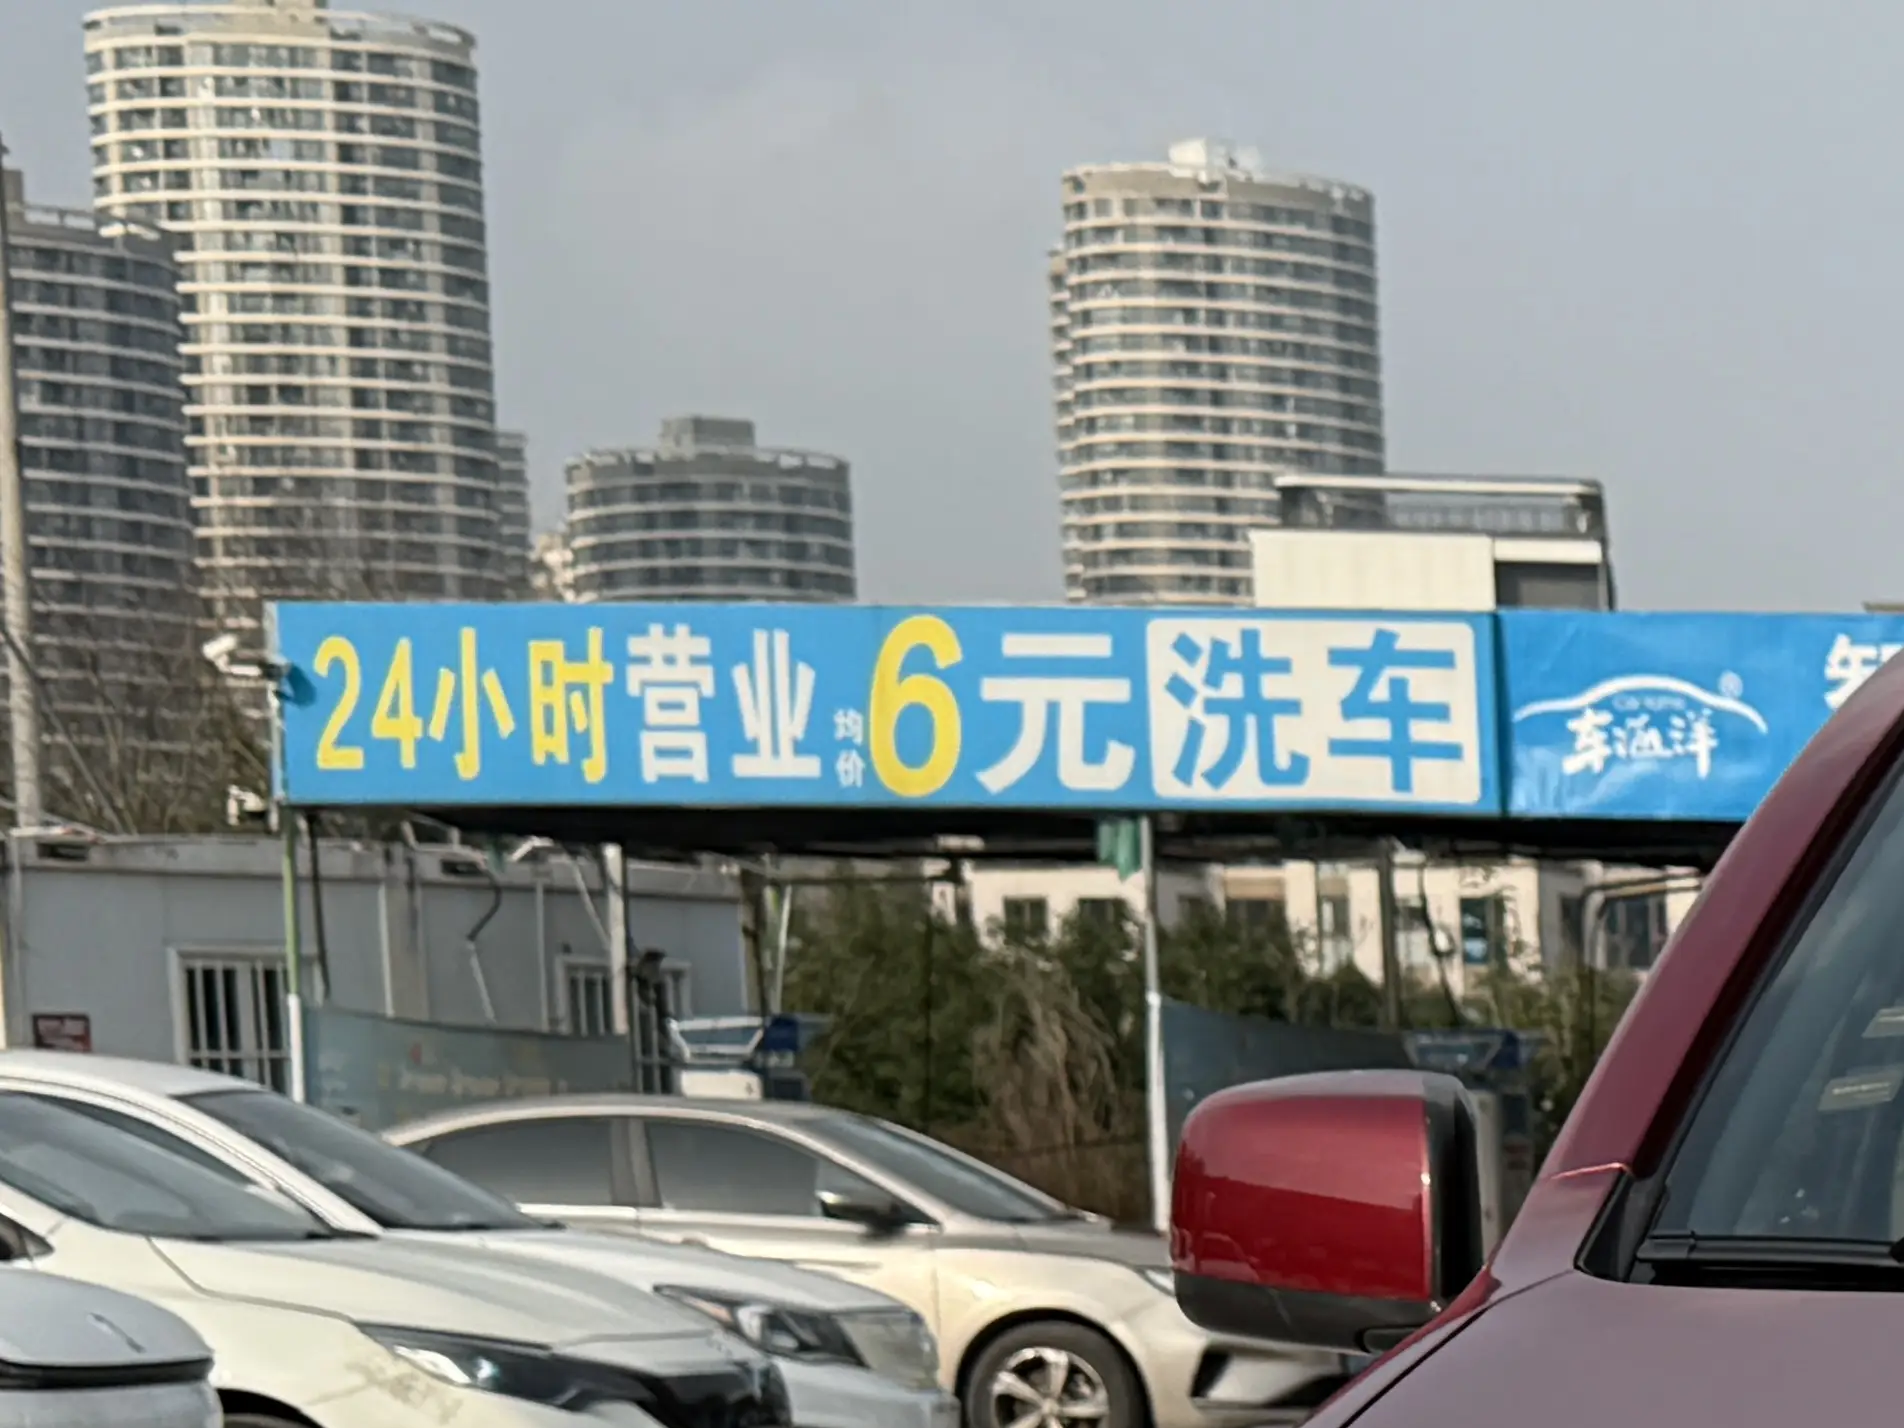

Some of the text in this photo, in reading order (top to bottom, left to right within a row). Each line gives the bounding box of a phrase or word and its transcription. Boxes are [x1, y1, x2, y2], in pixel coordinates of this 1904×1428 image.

[313, 613, 1464, 798] 24小时营业 均价 6元洗车
